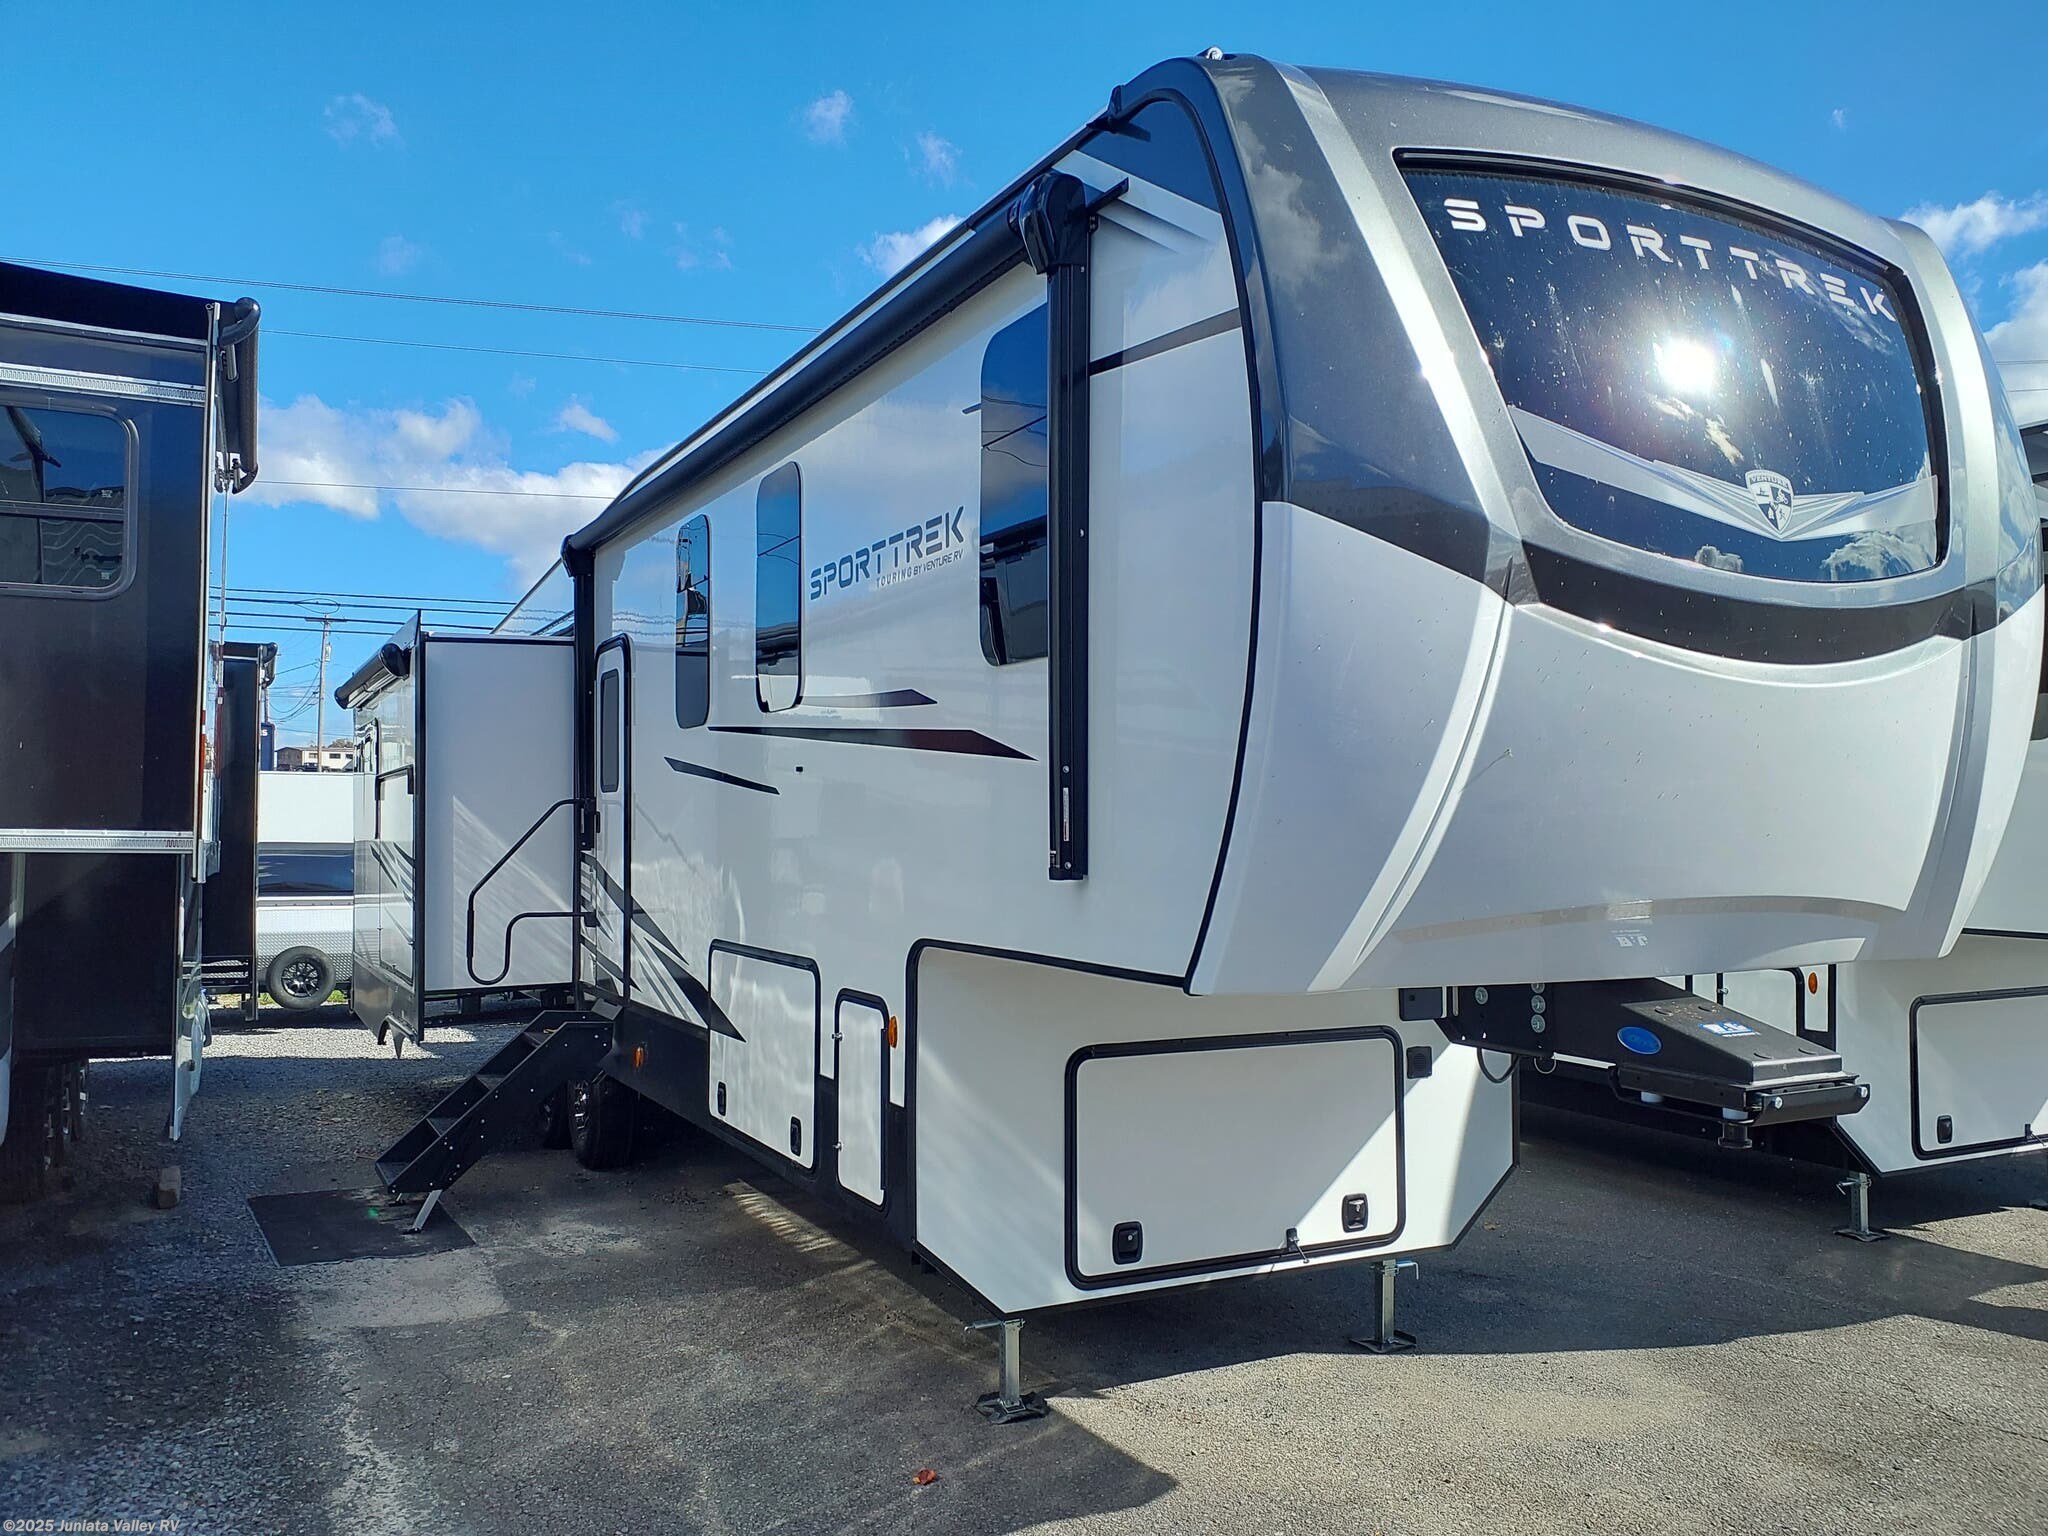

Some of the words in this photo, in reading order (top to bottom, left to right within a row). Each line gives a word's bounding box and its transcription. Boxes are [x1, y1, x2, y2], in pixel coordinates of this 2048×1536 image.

[810, 505, 964, 601] SPORTTREK
[876, 566, 912, 588] TOURING
[913, 564, 923, 576] BY
[923, 552, 953, 573] VENTURE
[953, 548, 964, 561] RV
